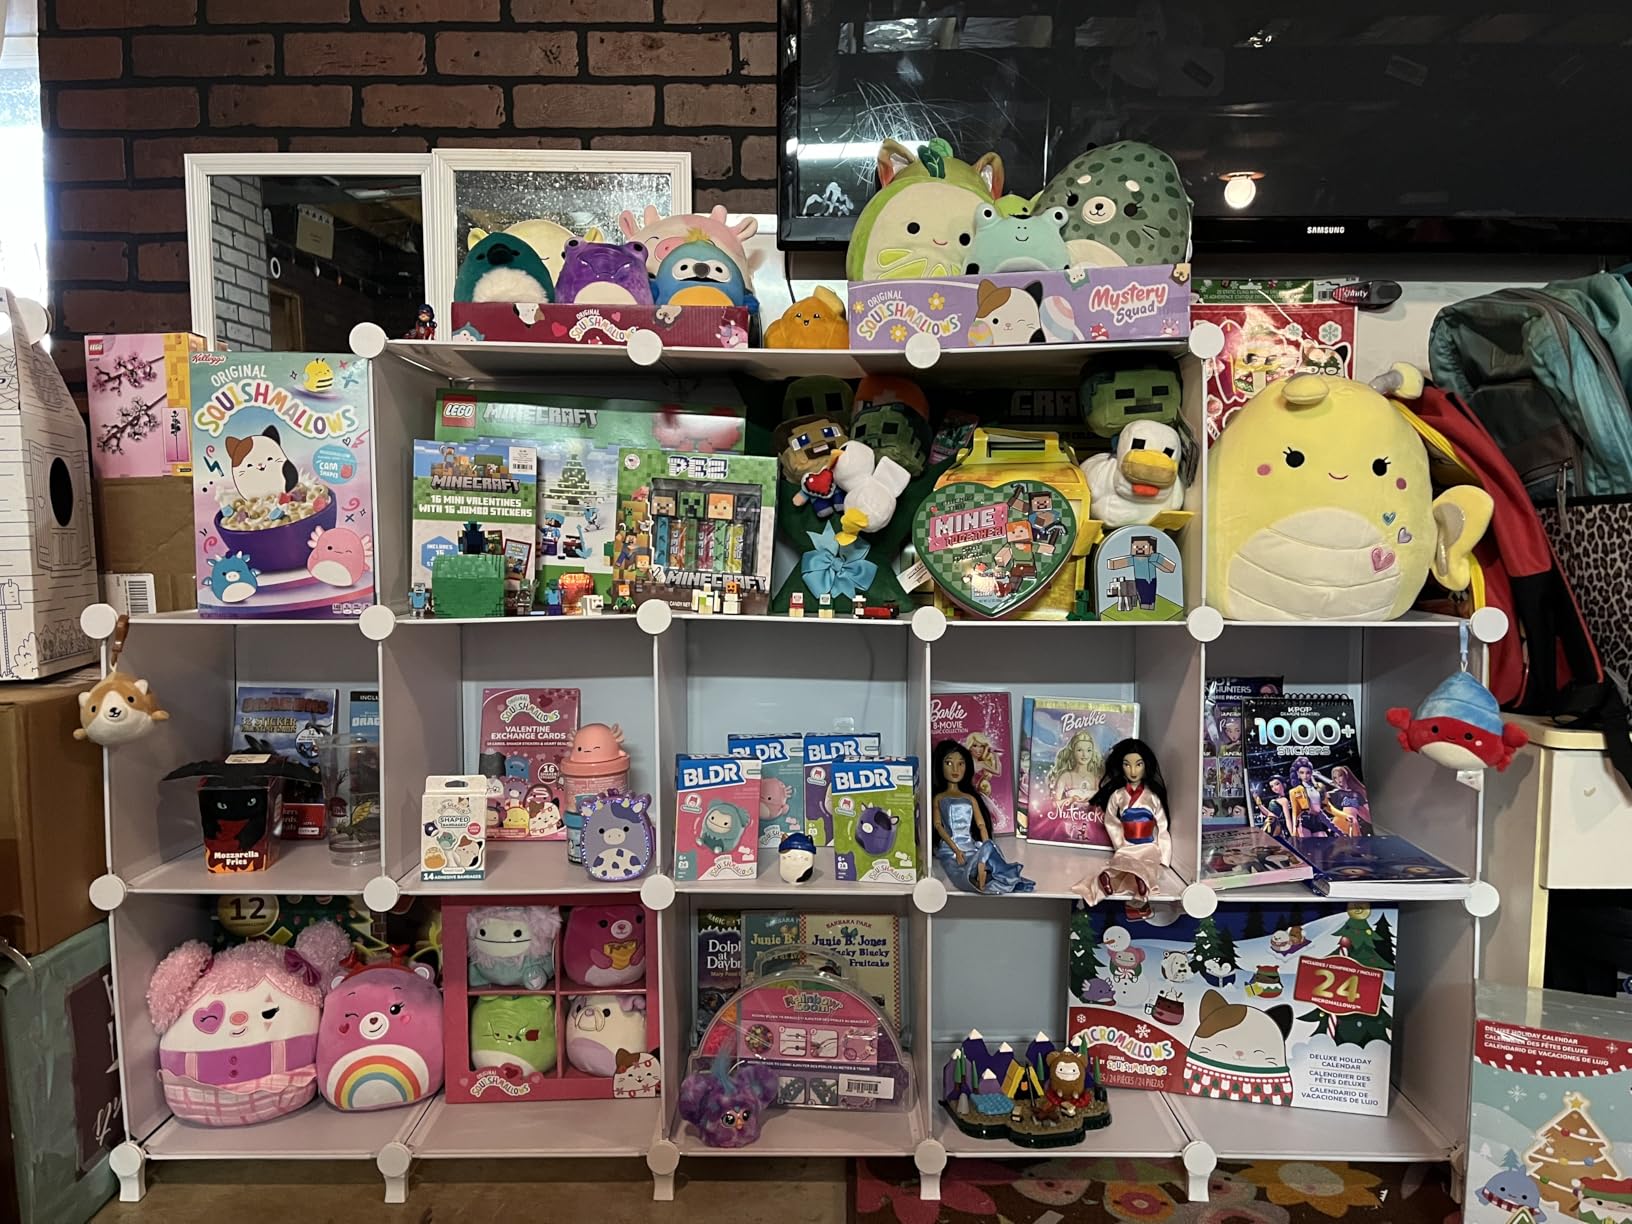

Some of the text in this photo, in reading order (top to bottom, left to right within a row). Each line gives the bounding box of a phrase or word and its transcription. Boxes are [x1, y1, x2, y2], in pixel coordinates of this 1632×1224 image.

[1307, 226, 1345, 234] SAMSUNG
[867, 290, 903, 308] ORIGINAL
[1090, 284, 1167, 311] Mystery
[576, 309, 601, 320] ORIGINAL
[1116, 301, 1155, 323] Squad
[858, 301, 960, 339] SQUISHMALLOWS
[89, 343, 103, 352] LEGO
[192, 353, 226, 365] Kellogg's
[210, 364, 267, 387] ORIGINAL
[196, 381, 357, 436] SQUISHMALLOWS
[444, 403, 475, 418] LEGO
[483, 402, 598, 429] MINECRAFT
[319, 462, 338, 471] CAM
[668, 456, 729, 479] PEZ
[430, 475, 520, 495] MINECRAFT
[444, 496, 460, 505] MINI
[466, 497, 522, 508] VALENTINES
[418, 504, 442, 514] WITH
[456, 506, 490, 516] JUMBO
[490, 508, 533, 518] STICKERS
[935, 508, 996, 538] MINE
[944, 526, 1003, 547] TOGETHER
[665, 570, 767, 592] MINECRAFT
[670, 600, 682, 608] CANDY
[1216, 686, 1252, 694] HUNTERS
[501, 702, 560, 723] SQUISHMALLOWS
[931, 699, 968, 722] Barbie
[254, 718, 297, 727] STICKER
[1061, 710, 1106, 733] Barbie
[491, 732, 536, 740] EXCHANGE
[1254, 717, 1356, 746] 1000+
[808, 740, 860, 762] BLDR
[1276, 746, 1331, 756] STICKERS
[684, 764, 740, 786] BLDR
[834, 768, 890, 790] BLDR
[214, 851, 259, 860] Mozzarella
[226, 858, 248, 866] Fries
[230, 897, 266, 920] 12
[826, 920, 872, 929] BARBARA PARK
[750, 933, 796, 945] Junie B.
[812, 934, 887, 946] Junie B. Jones
[718, 952, 728, 960] at
[859, 948, 890, 958] Blucky
[706, 956, 742, 971] Daybr
[849, 959, 890, 967] Fruitcake
[1301, 959, 1326, 968] INCLUDES
[1329, 964, 1356, 974] COMPREND
[1312, 969, 1360, 1002] 24
[783, 992, 843, 1010] Rainbow
[794, 1002, 830, 1014] Loom
[1484, 1034, 1526, 1045] CALEER
[1541, 1040, 1560, 1050] FÊTES
[1562, 1046, 1588, 1054] DELUXE
[1511, 1030, 1541, 1039] HOLIDAY
[1542, 1034, 1578, 1044] CALENDAR
[1309, 1053, 1372, 1065] DELUXE HOLIDAY
[1484, 1042, 1526, 1053] CALENDARIO
[1538, 1050, 1580, 1062] VACACIONES
[1592, 1058, 1609, 1066] LUJO
[1106, 1060, 1167, 1076] SQUISHMALLOWS
[1322, 1061, 1361, 1070] CALENDAR
[1110, 1074, 1116, 1082] 24
[1117, 1074, 1134, 1084] PIÈCES
[1138, 1078, 1145, 1086] 24
[1146, 1078, 1164, 1088] PIEZAS
[1309, 1070, 1370, 1082] CALENDRIER DES
[1314, 1076, 1366, 1088] FÊTES DELUXE
[470, 1076, 530, 1098] SQUISHMALLOWS
[1310, 1087, 1357, 1096] CALENDARIO
[1301, 1092, 1347, 1102] VACACIONES
